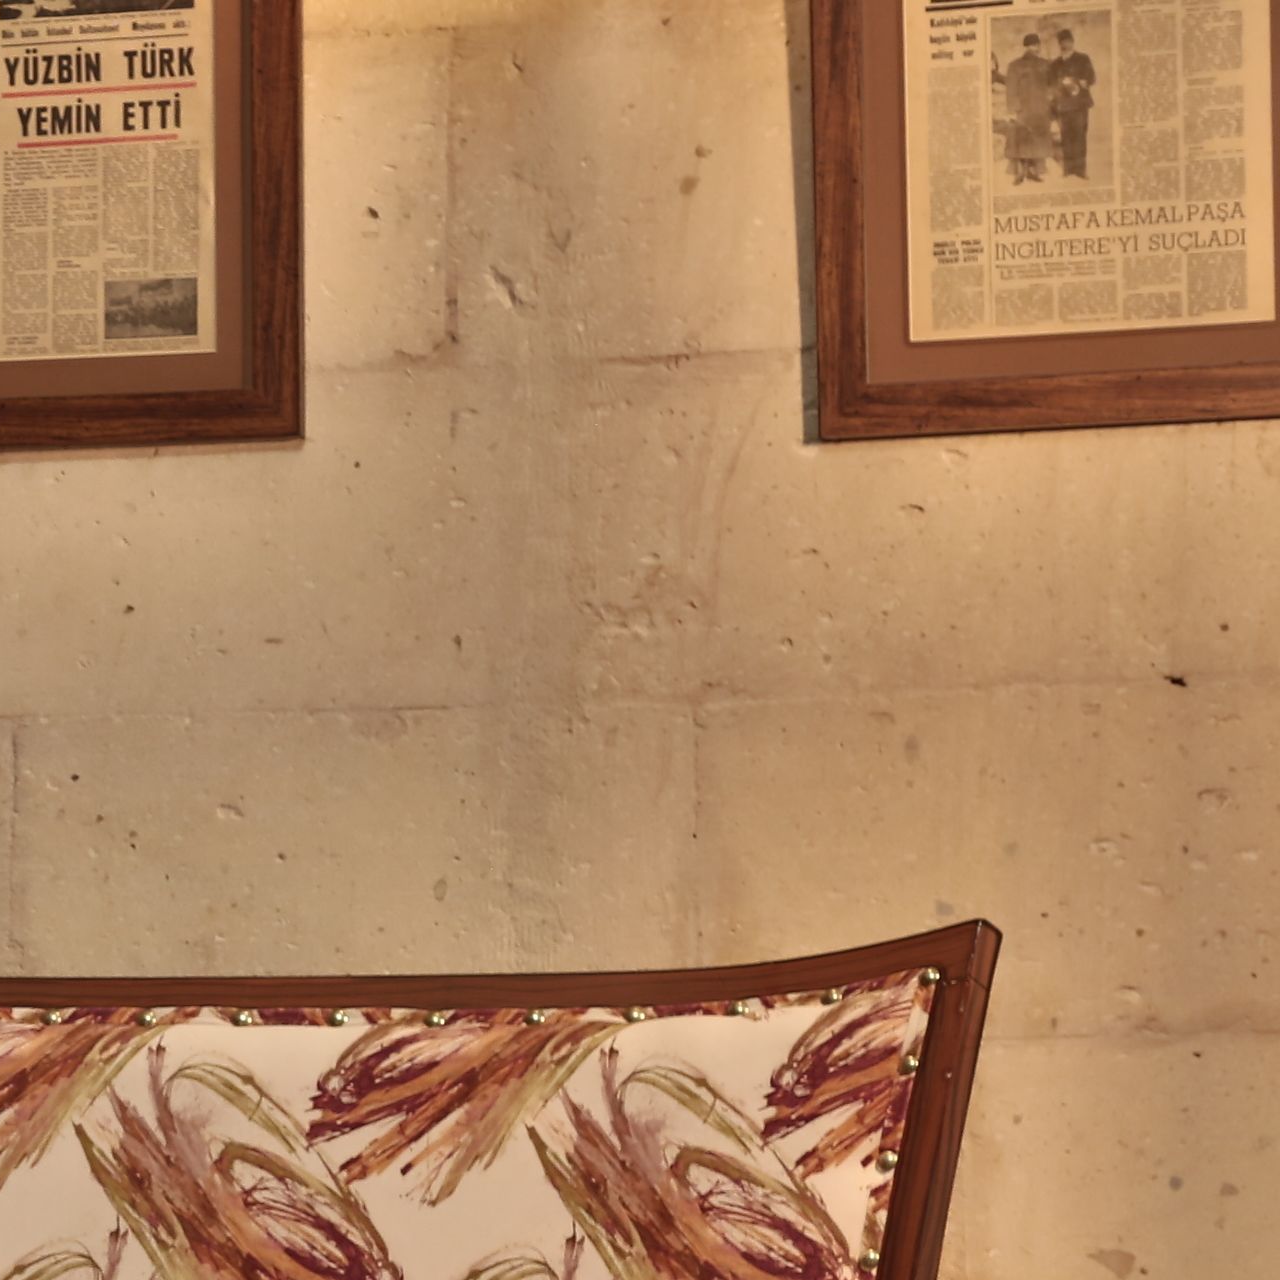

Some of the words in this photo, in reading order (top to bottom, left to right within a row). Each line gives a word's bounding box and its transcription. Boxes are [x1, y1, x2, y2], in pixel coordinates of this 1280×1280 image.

[4, 46, 101, 86] YÜZBİN
[123, 41, 195, 80] TÜRK
[17, 97, 101, 137] YEMİN
[122, 92, 182, 131] ETTİ
[993, 211, 1100, 235] MUSTAFA
[1106, 205, 1183, 227] KEMAL
[1187, 201, 1246, 223] PAŞA
[1148, 228, 1247, 252] SUÇLADI
